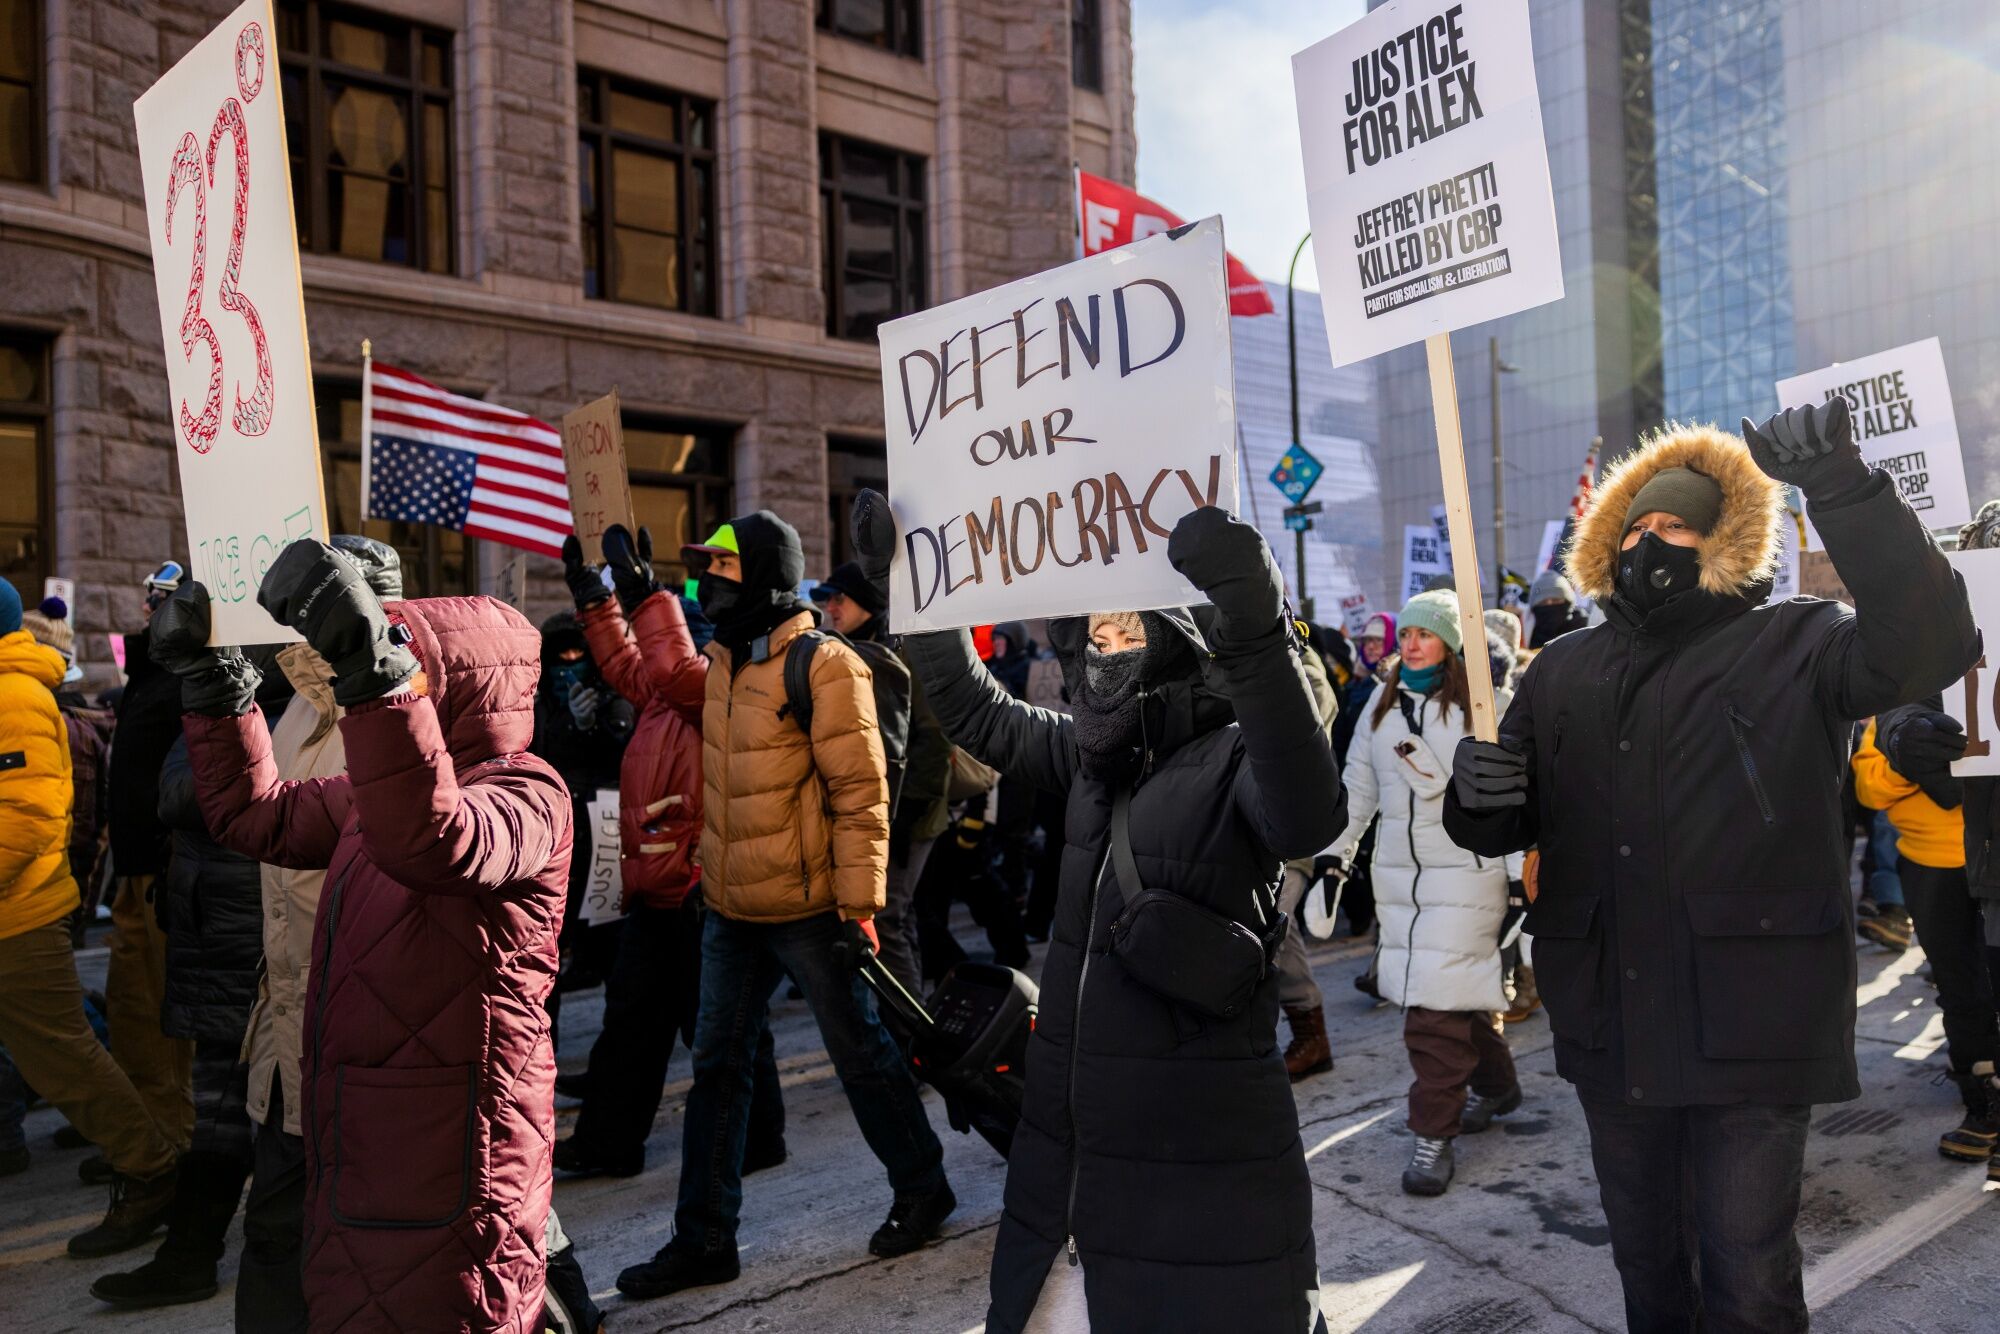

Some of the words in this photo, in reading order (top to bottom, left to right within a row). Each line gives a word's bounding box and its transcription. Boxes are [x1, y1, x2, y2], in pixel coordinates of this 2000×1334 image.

[1345, 3, 1469, 116] JUSTICE
[1343, 101, 1403, 175] FOR
[1405, 61, 1484, 149] ALEX
[1354, 188, 1425, 249] JEFFREY
[1427, 161, 1498, 220] PRETTI
[1357, 232, 1423, 290] KILLED
[1423, 219, 1454, 266] BY
[1457, 203, 1503, 254] CBP
[1366, 294, 1389, 314] PARTY
[1388, 289, 1404, 306] FOR
[1403, 274, 1444, 300] SOCIALISM
[1445, 272, 1458, 287] &
[1457, 254, 1508, 283] LIBERATION
[899, 279, 1186, 445] DEFEND
[1825, 370, 1908, 412] STICE
[570, 419, 613, 462] PRISON
[970, 408, 1098, 466] OUR
[1864, 399, 1918, 439] ALEX
[1899, 472, 1929, 495] CBP
[583, 511, 605, 538] ICE
[905, 455, 1220, 614] DEMOCRACY
[588, 810, 620, 911] JUSTICE
